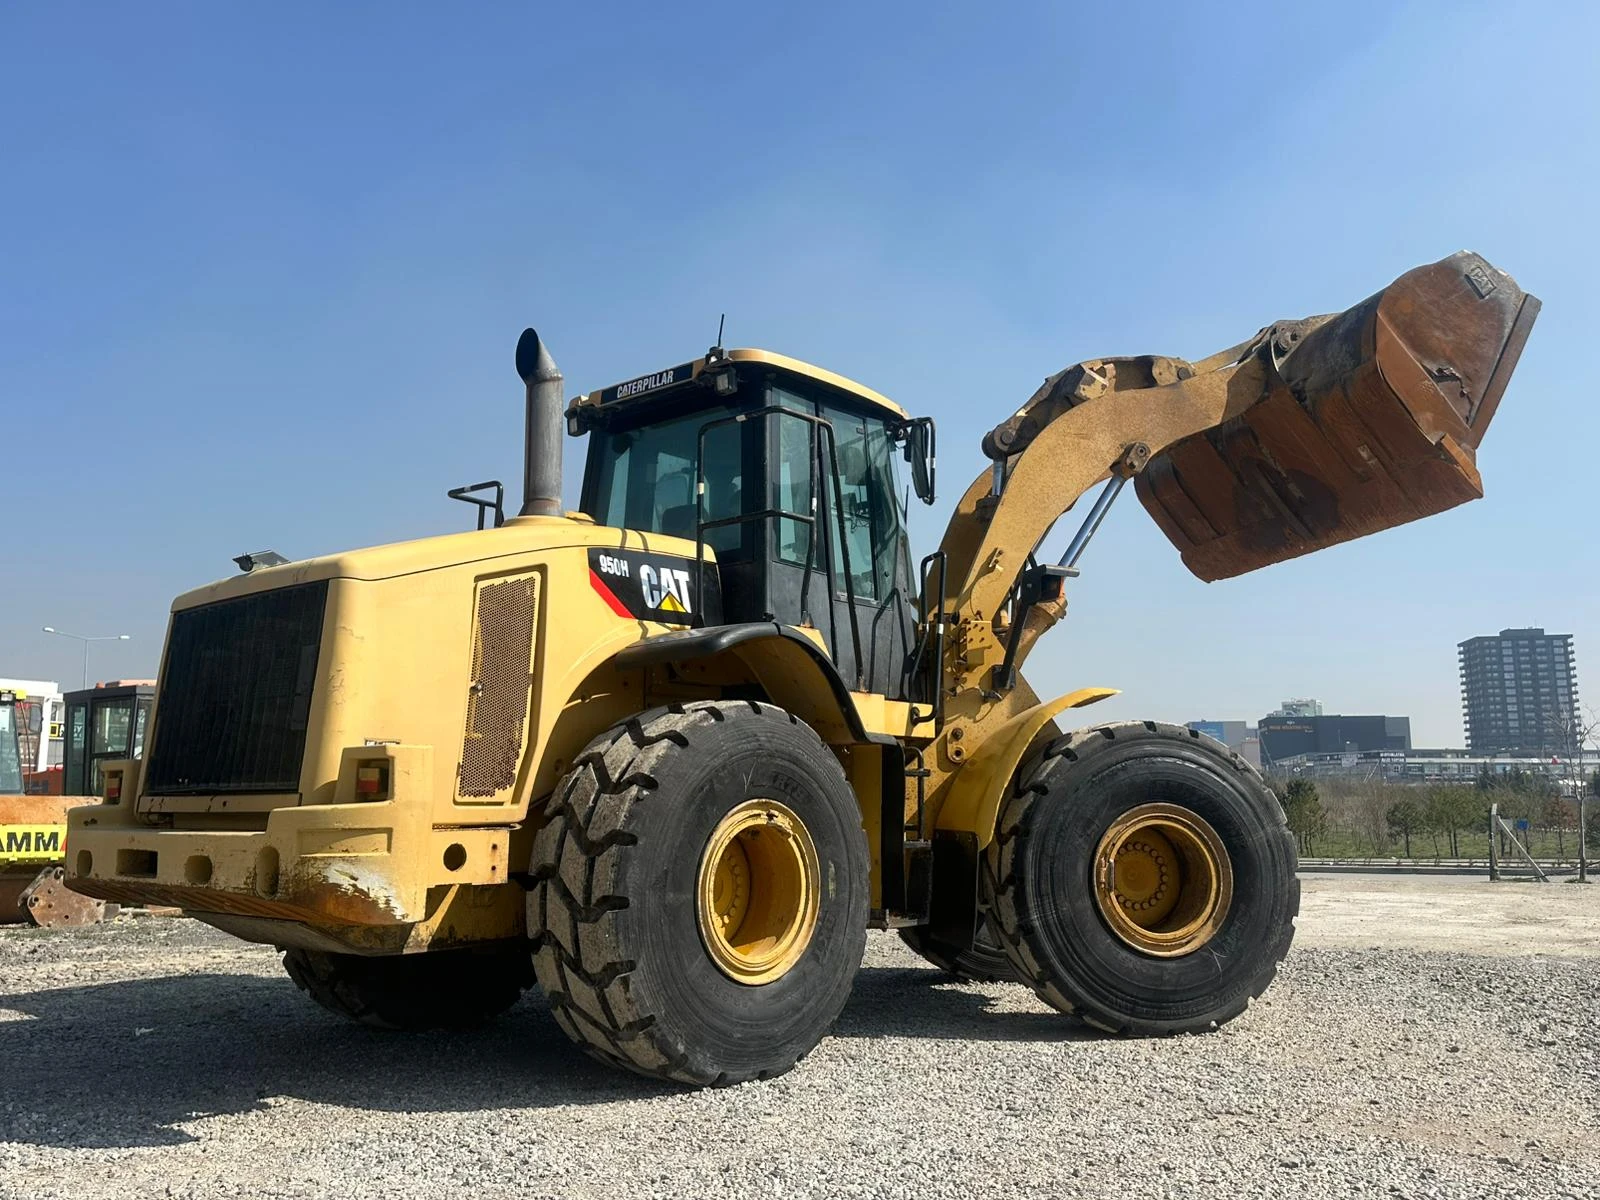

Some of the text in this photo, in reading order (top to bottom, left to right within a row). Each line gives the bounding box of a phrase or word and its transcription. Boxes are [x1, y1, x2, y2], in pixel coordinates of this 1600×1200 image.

[616, 370, 674, 398] CATERPILLAR
[599, 554, 630, 578] 950H
[639, 564, 692, 614] CAT
[0, 831, 59, 852] MM
